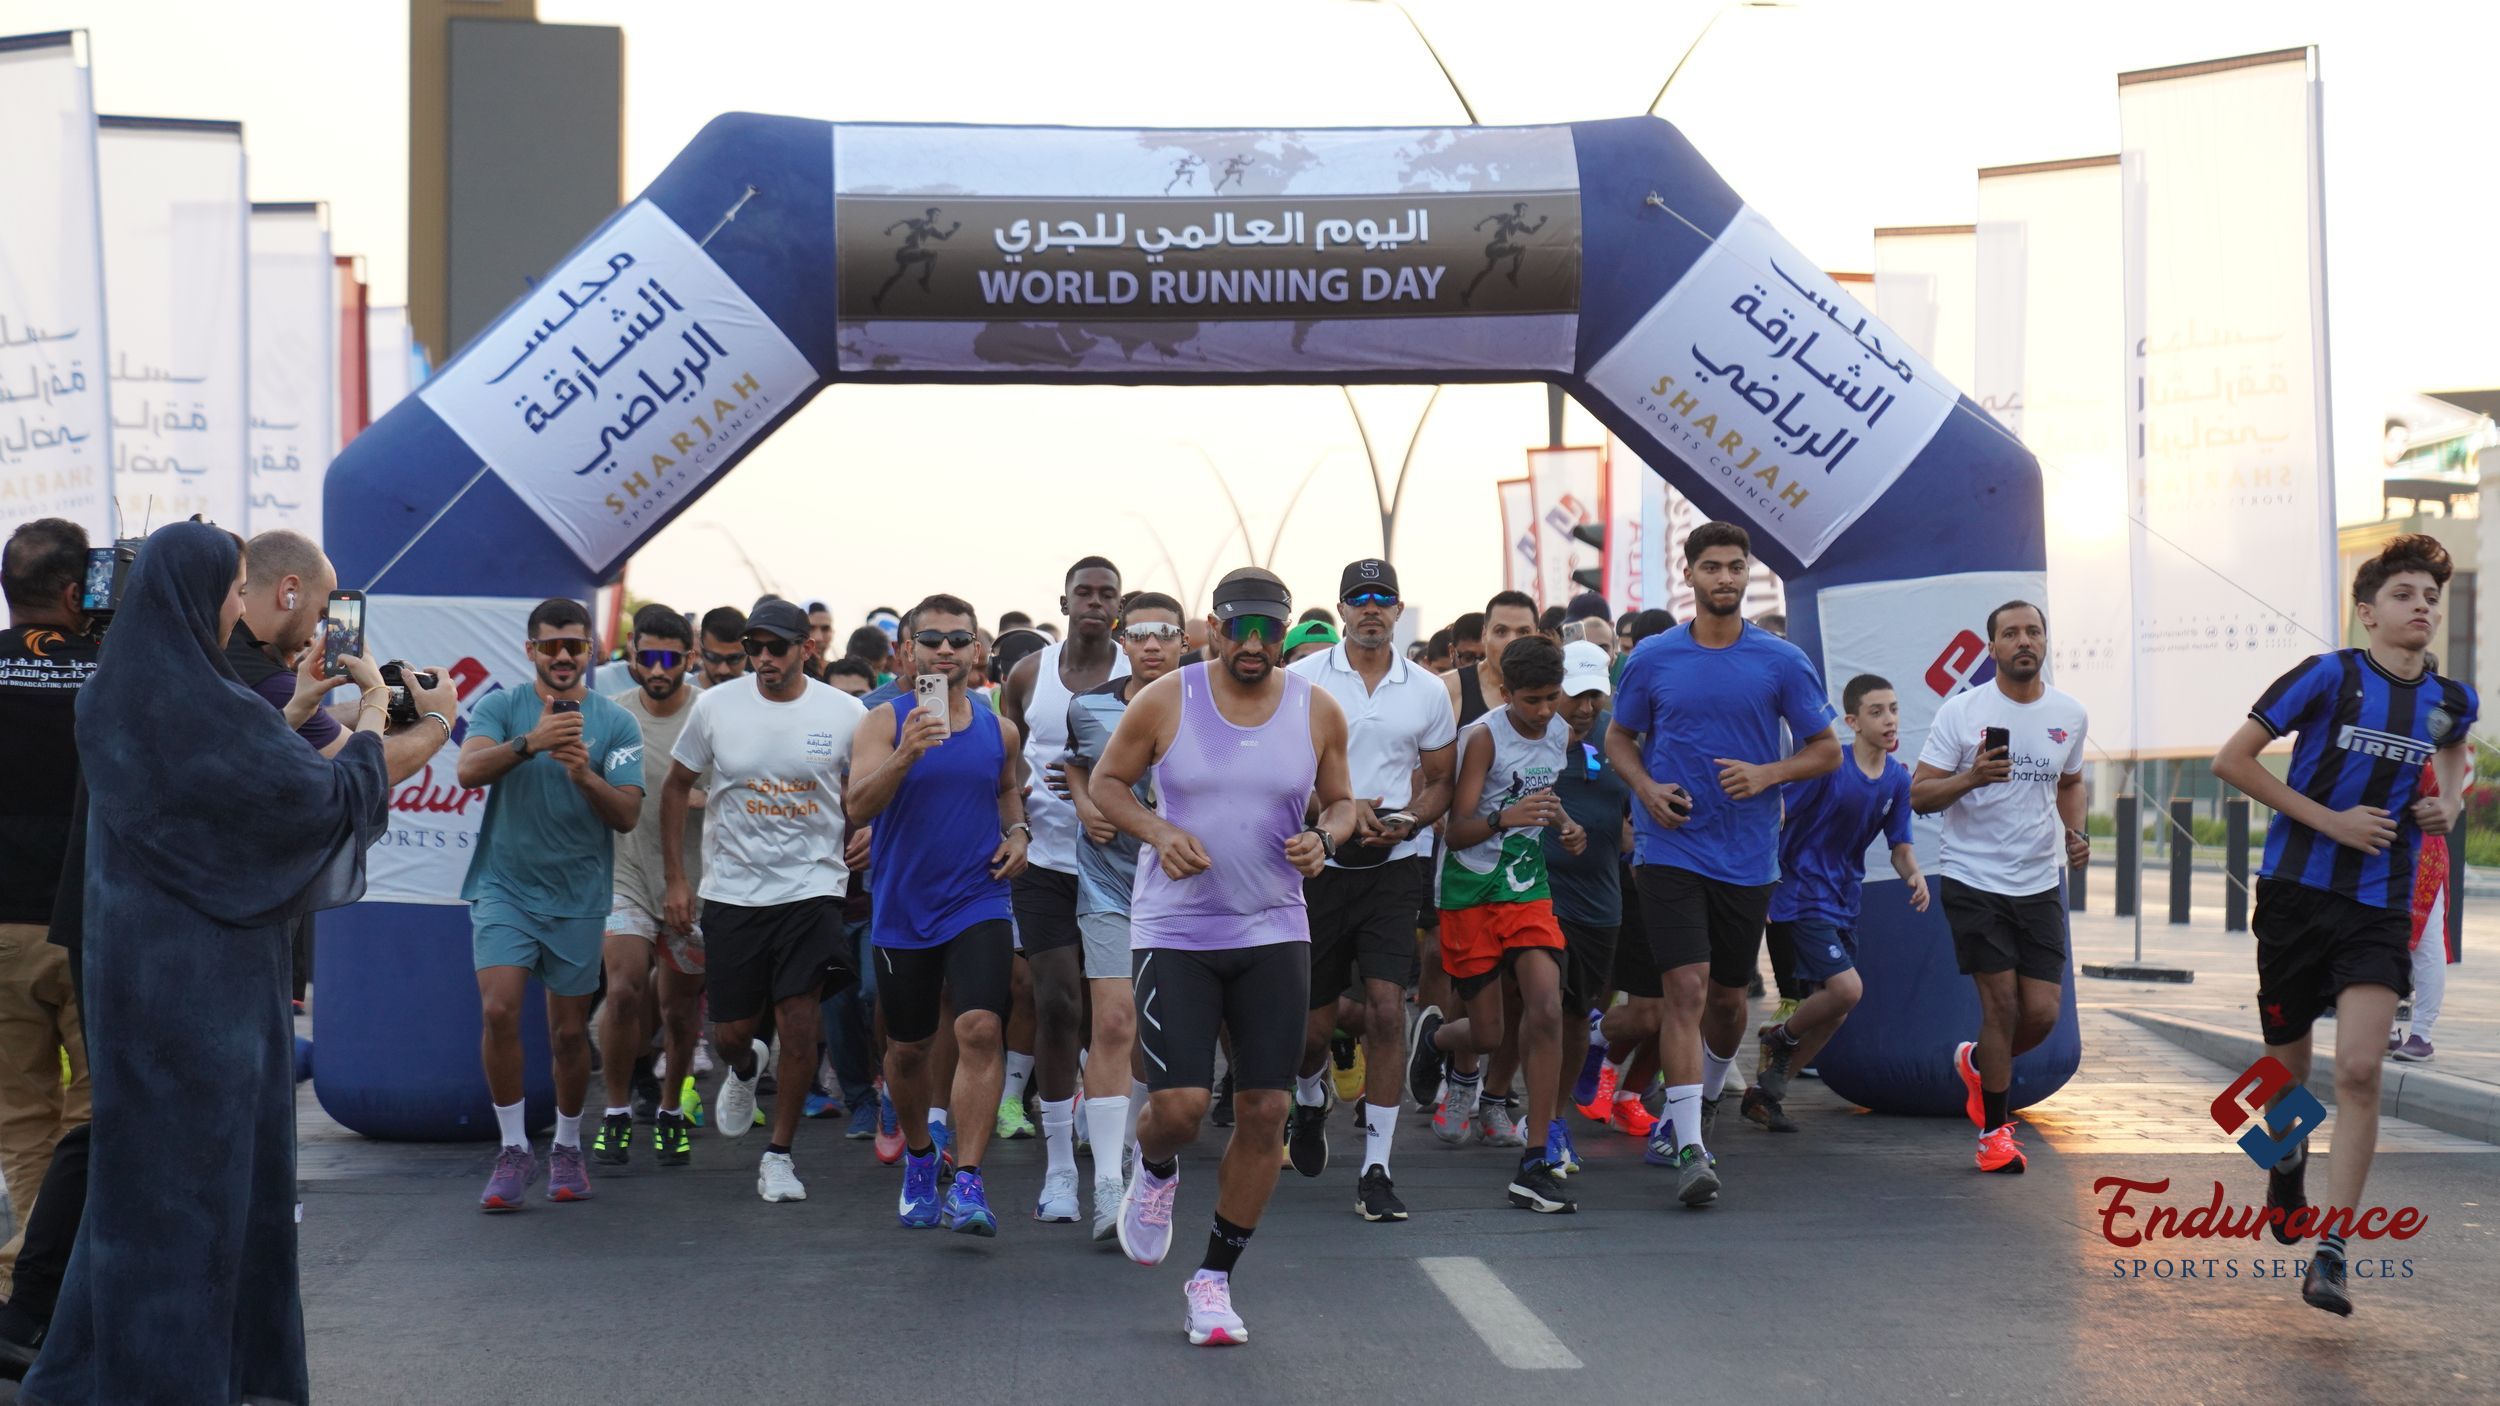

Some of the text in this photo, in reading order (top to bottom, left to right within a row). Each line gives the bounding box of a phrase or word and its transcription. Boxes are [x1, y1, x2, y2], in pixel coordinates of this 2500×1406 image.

[993, 209, 1429, 263] اليوم العالمي للجري
[485, 252, 637, 385] مجلس
[978, 264, 1446, 306] WORLD RUNNING DAY
[1770, 256, 1914, 384] مجلس
[514, 278, 685, 434] الشارقة
[574, 321, 730, 476] الرياضي
[1730, 284, 1896, 429] الشارقة
[605, 371, 761, 515] SHARJAH
[1651, 376, 1810, 509] SHARJAH
[1691, 342, 1860, 474] الرياضي
[623, 395, 772, 528] SPORTS COUNCIL
[1637, 395, 1785, 522] SPORTS COUNCIL
[0, 658, 41, 667] الشار
[10, 680, 61, 688] BROADCASTING
[746, 776, 817, 797] الشارقة
[746, 799, 818, 819] Sharjah
[1524, 767, 1553, 776] PAKISTAN
[1524, 775, 1549, 787] ROAD
[2012, 769, 2058, 782] harbash
[379, 830, 446, 848] ORTS
